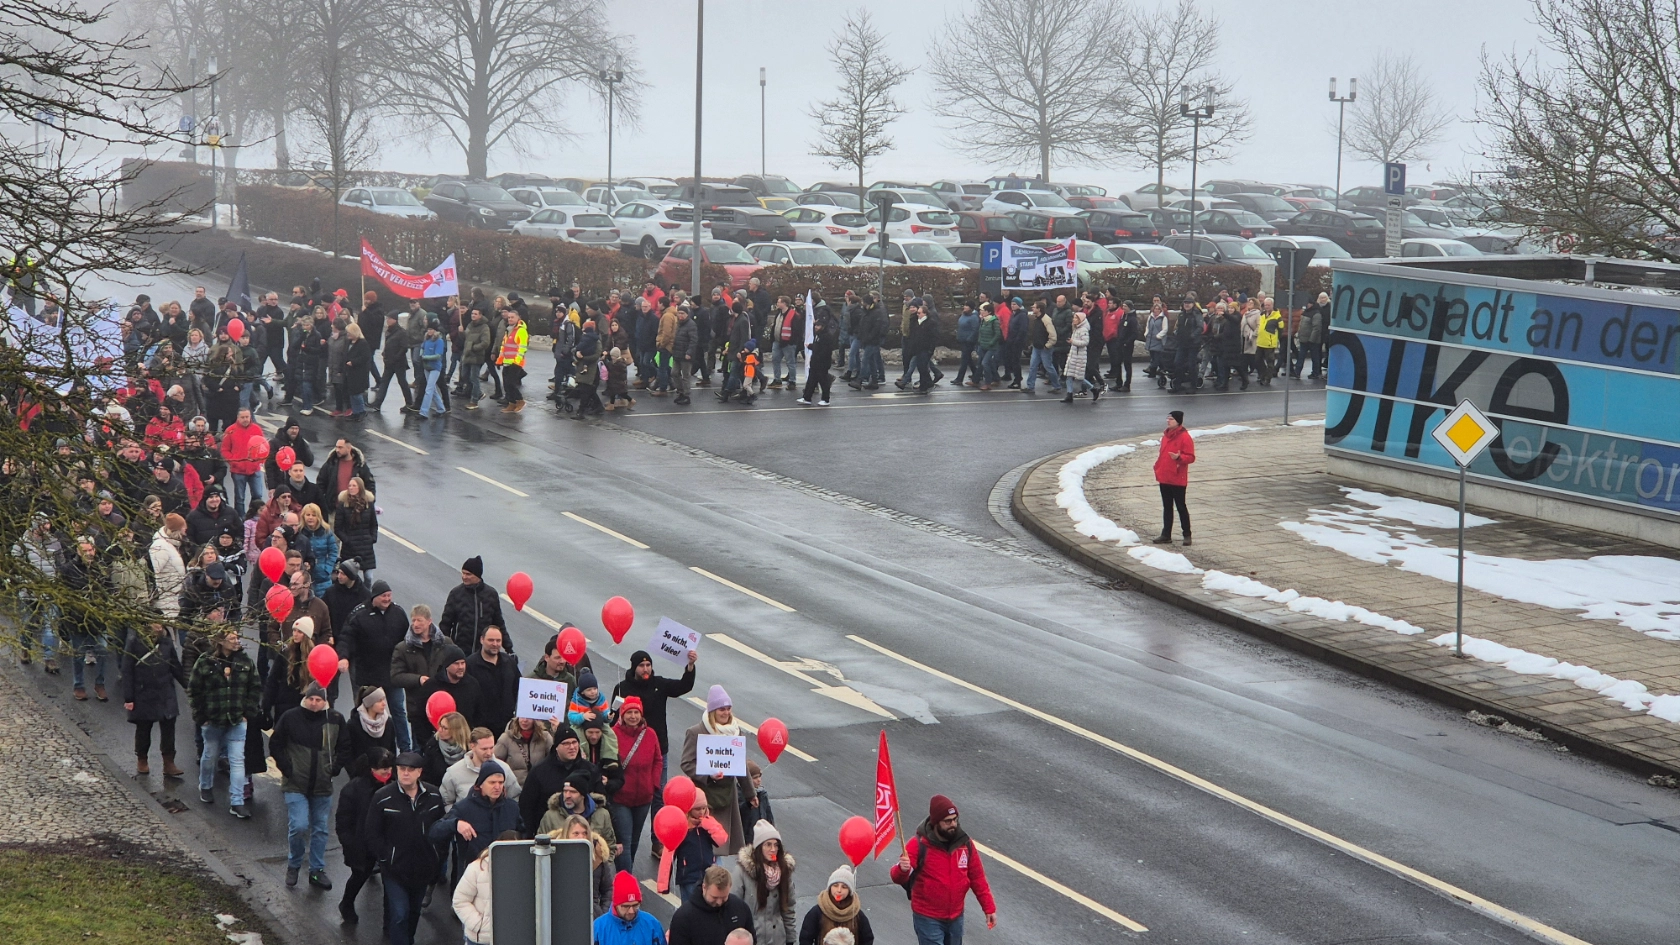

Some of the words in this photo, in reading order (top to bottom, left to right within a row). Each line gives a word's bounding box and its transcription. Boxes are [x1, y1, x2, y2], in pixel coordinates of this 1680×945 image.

[1389, 166, 1401, 191] P
[989, 248, 999, 263] P
[1331, 283, 1515, 343] neustadt
[1526, 307, 1584, 352] an
[1599, 303, 1680, 365] der
[663, 630, 671, 639] So
[671, 635, 688, 649] nicht,
[660, 642, 681, 657] Valeo!
[529, 690, 538, 699] So
[540, 692, 559, 702] nicht,
[532, 704, 555, 714] Valeo!
[705, 746, 714, 755] So
[715, 747, 735, 757] nicht,
[709, 760, 731, 769] Valeo!
